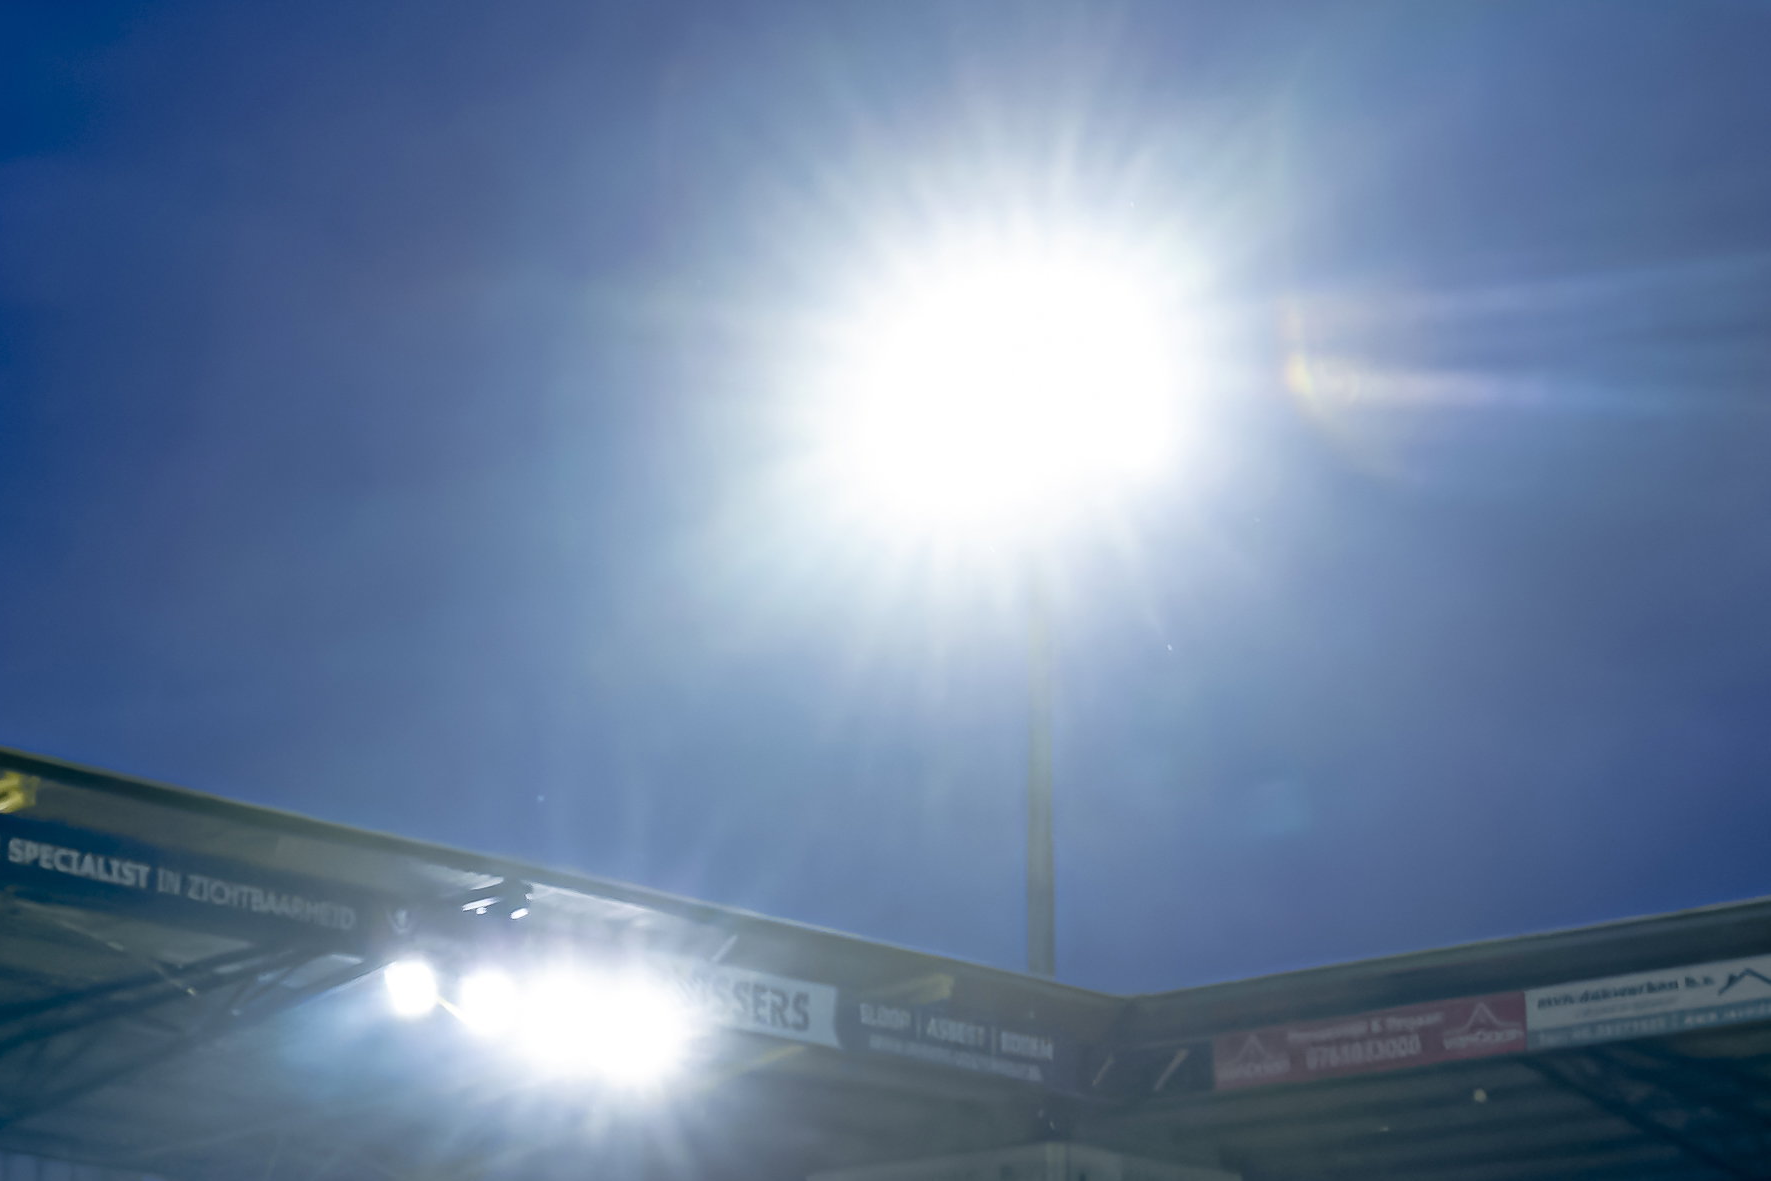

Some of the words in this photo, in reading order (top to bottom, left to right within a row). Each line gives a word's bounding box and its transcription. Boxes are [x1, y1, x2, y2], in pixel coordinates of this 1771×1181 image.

[8, 837, 150, 889] SPECIALIST
[158, 867, 181, 894] IN
[187, 874, 356, 930] ZICHTBAARHEID
